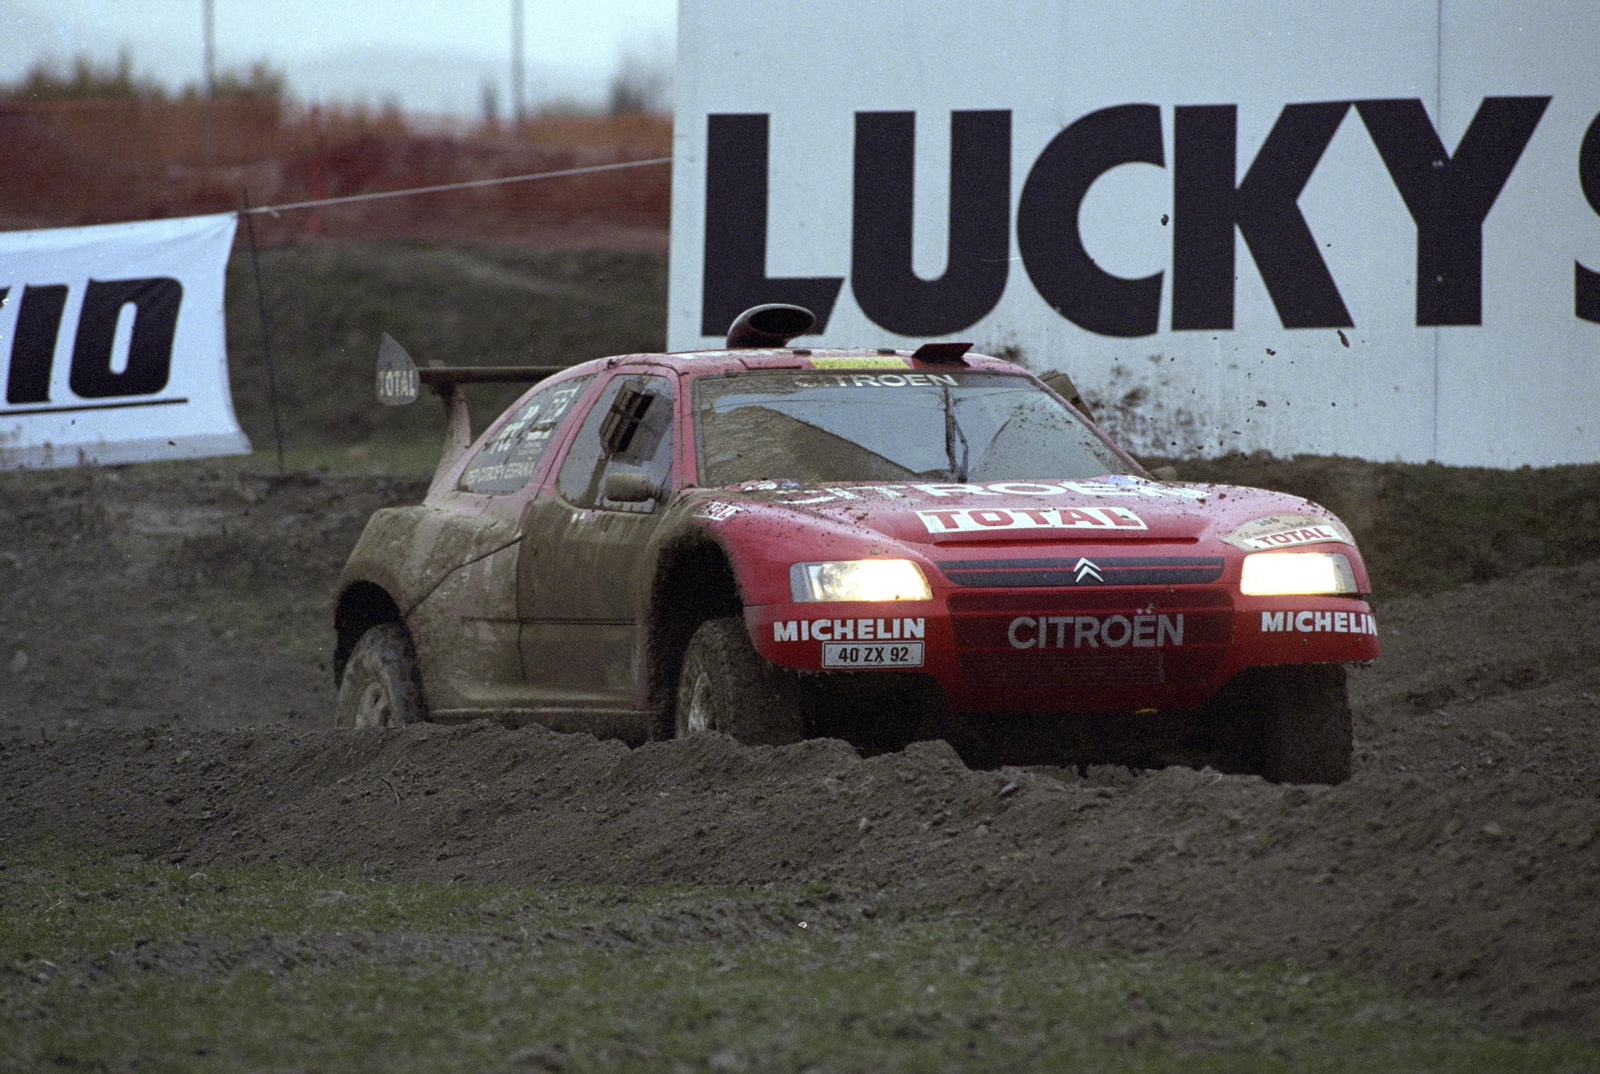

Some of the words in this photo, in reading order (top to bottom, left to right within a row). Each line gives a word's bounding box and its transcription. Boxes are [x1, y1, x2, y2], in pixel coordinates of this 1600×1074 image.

[702, 95, 1553, 337] LUCKY
[378, 370, 416, 397] TOTAL
[795, 374, 959, 387] CTROEN
[921, 508, 1143, 530] TOTAL
[1255, 527, 1332, 546] TOTAL
[773, 617, 925, 642] MICHELIN
[1007, 607, 1184, 649] CITROËN
[1261, 610, 1378, 636] MICHELIN
[838, 647, 859, 663] 40
[864, 646, 884, 662] ZX
[890, 646, 909, 662] 92
